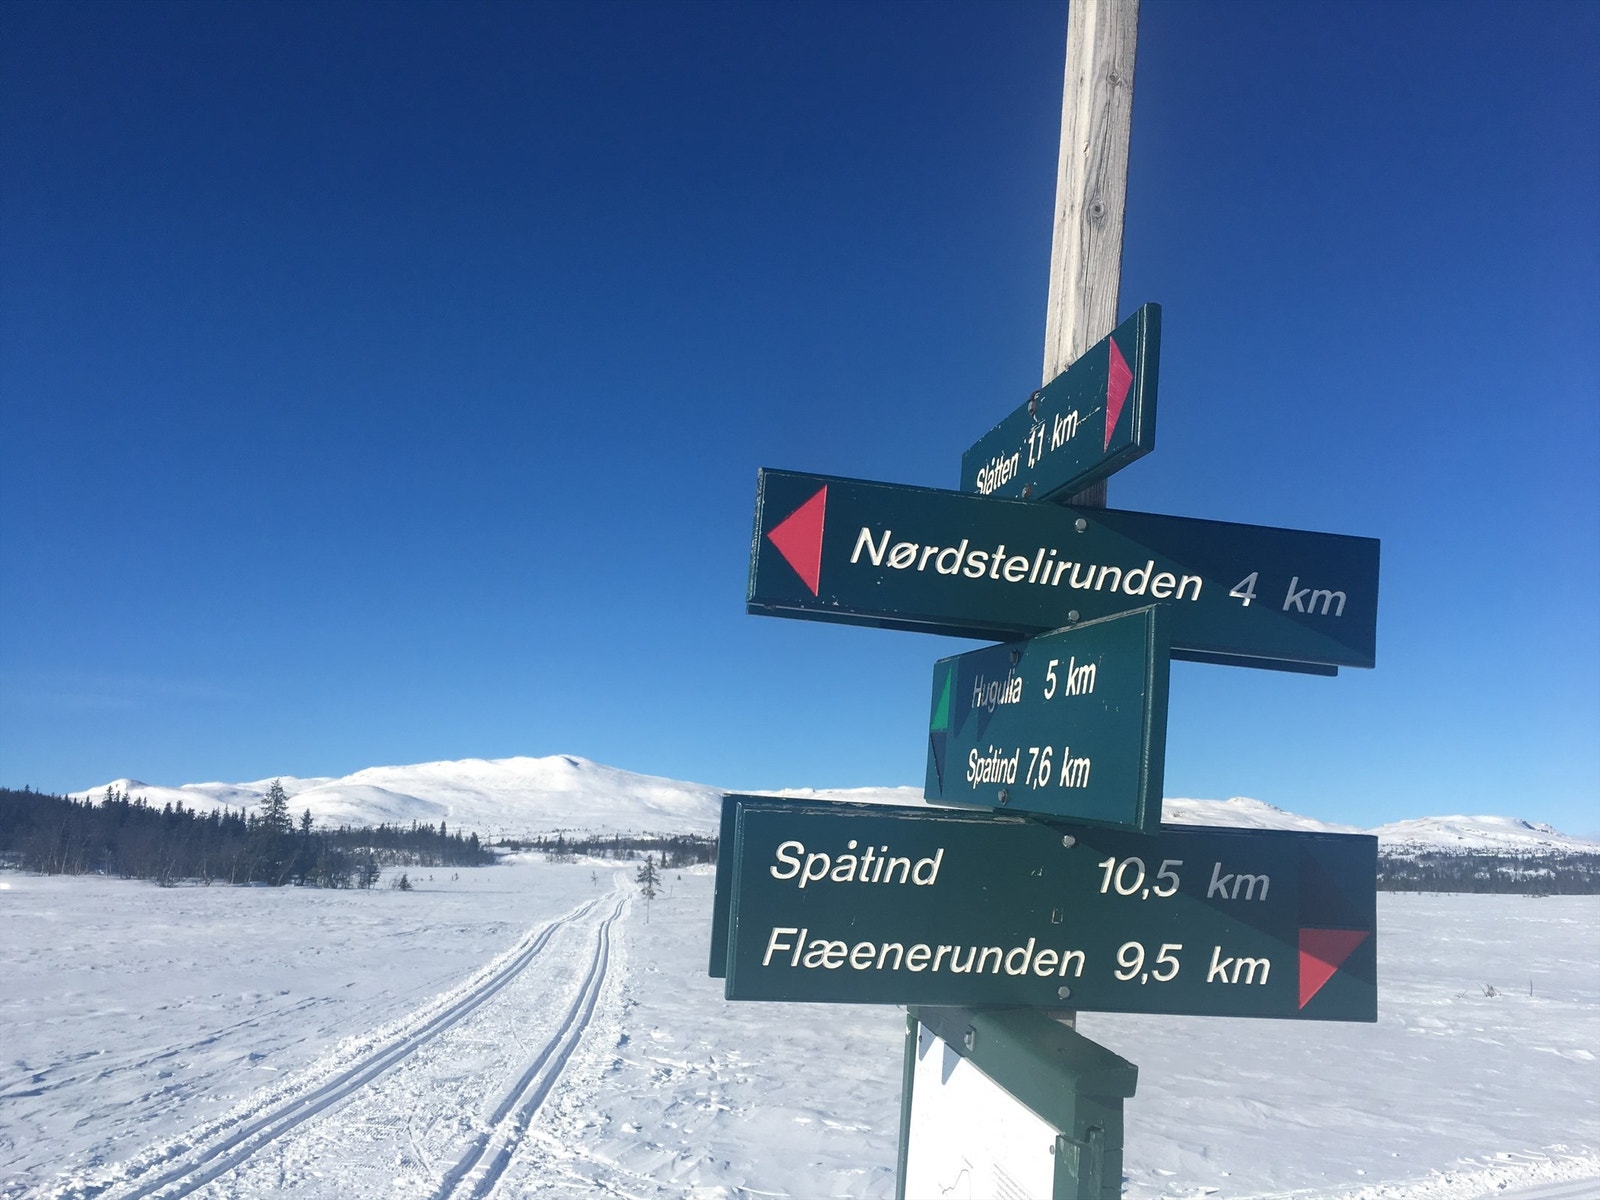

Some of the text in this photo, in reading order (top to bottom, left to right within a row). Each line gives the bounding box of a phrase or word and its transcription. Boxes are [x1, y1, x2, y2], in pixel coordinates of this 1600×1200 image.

[1051, 409, 1079, 451] km
[850, 526, 1347, 617] Nørdstelirunden 4 km
[971, 656, 1097, 713] Hugulia 5 km
[966, 745, 1091, 790] Spåtind 7,6 km
[769, 840, 1271, 902] Spåtind 10,5 km
[762, 927, 1271, 986] Flæenerunden 9,5 km
